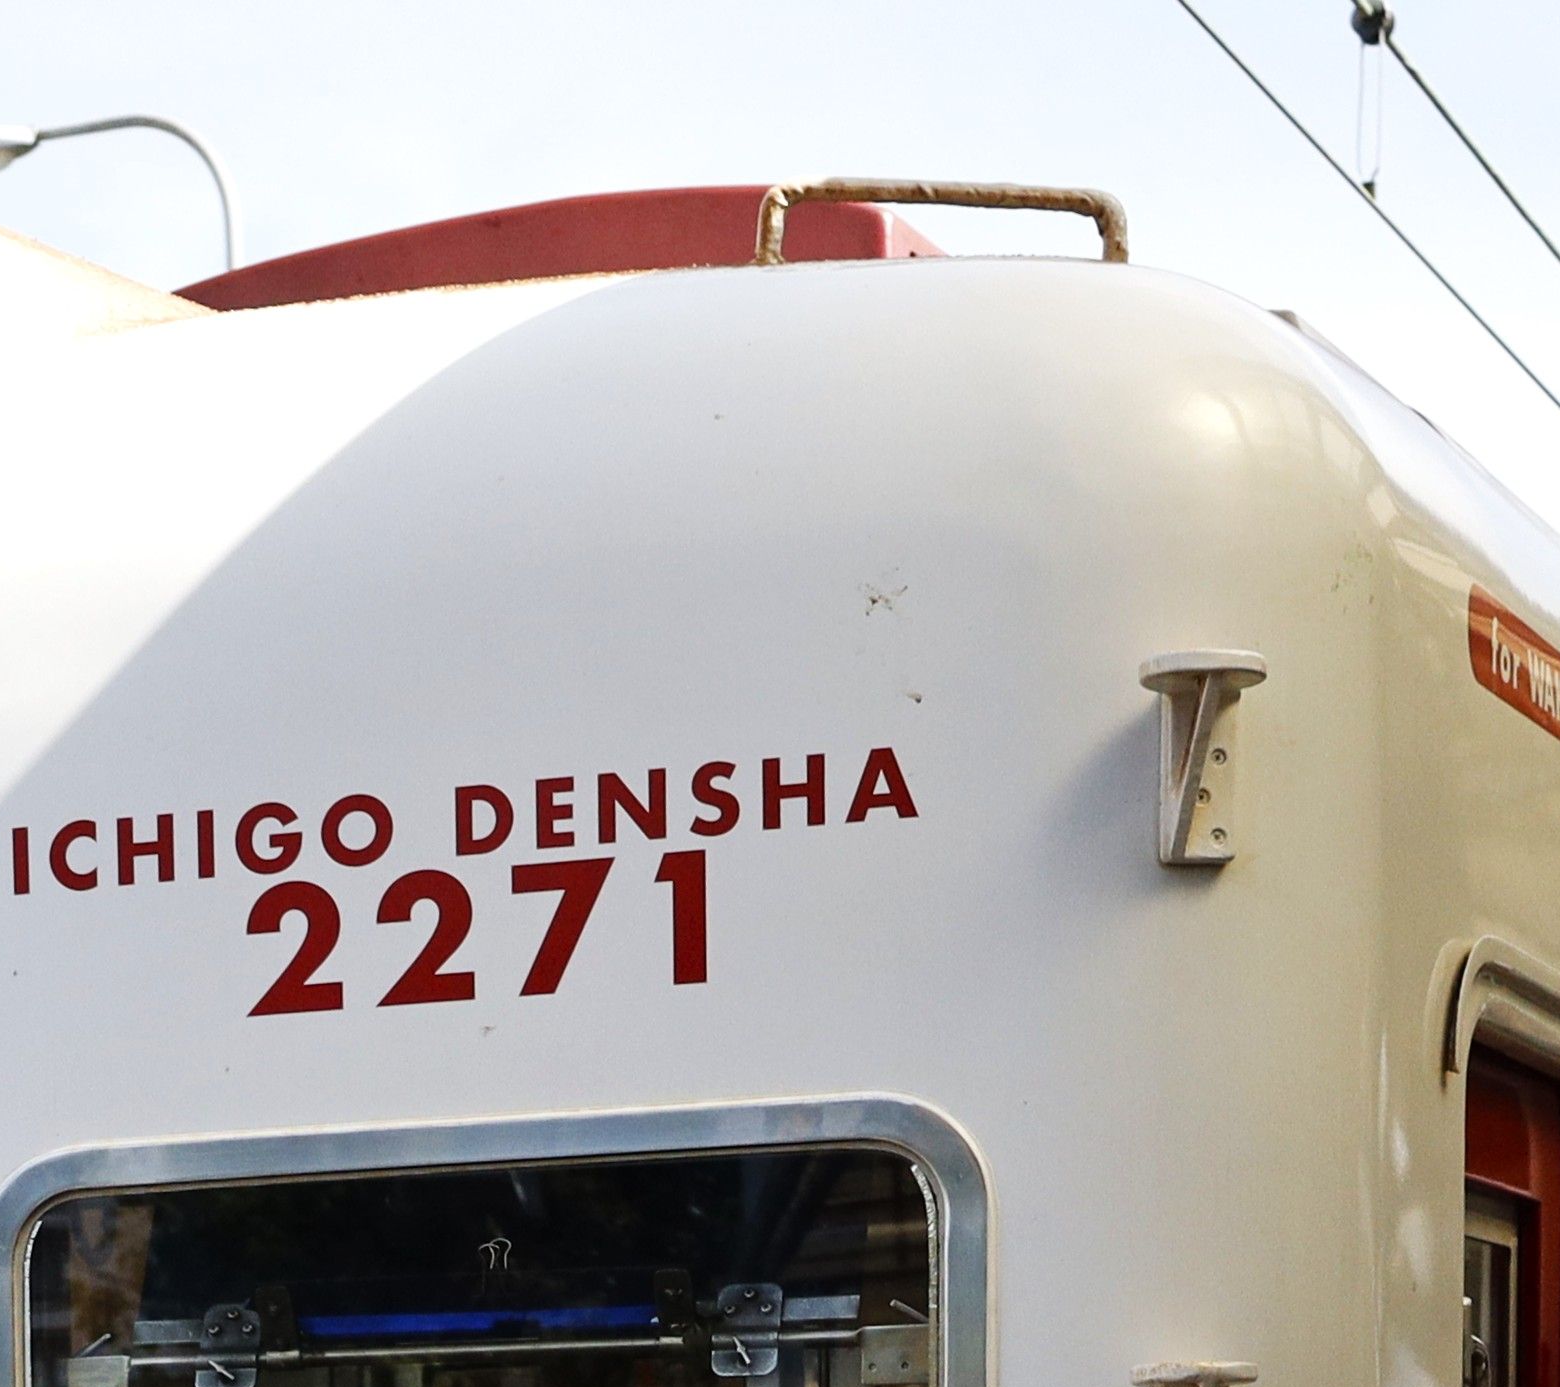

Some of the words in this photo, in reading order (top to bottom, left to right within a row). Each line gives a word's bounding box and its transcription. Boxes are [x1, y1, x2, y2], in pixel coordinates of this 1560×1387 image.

[1492, 616, 1520, 689] for
[11, 793, 394, 895] ICHIGO
[454, 746, 918, 856] DENSHA
[246, 849, 709, 1018] 2271
